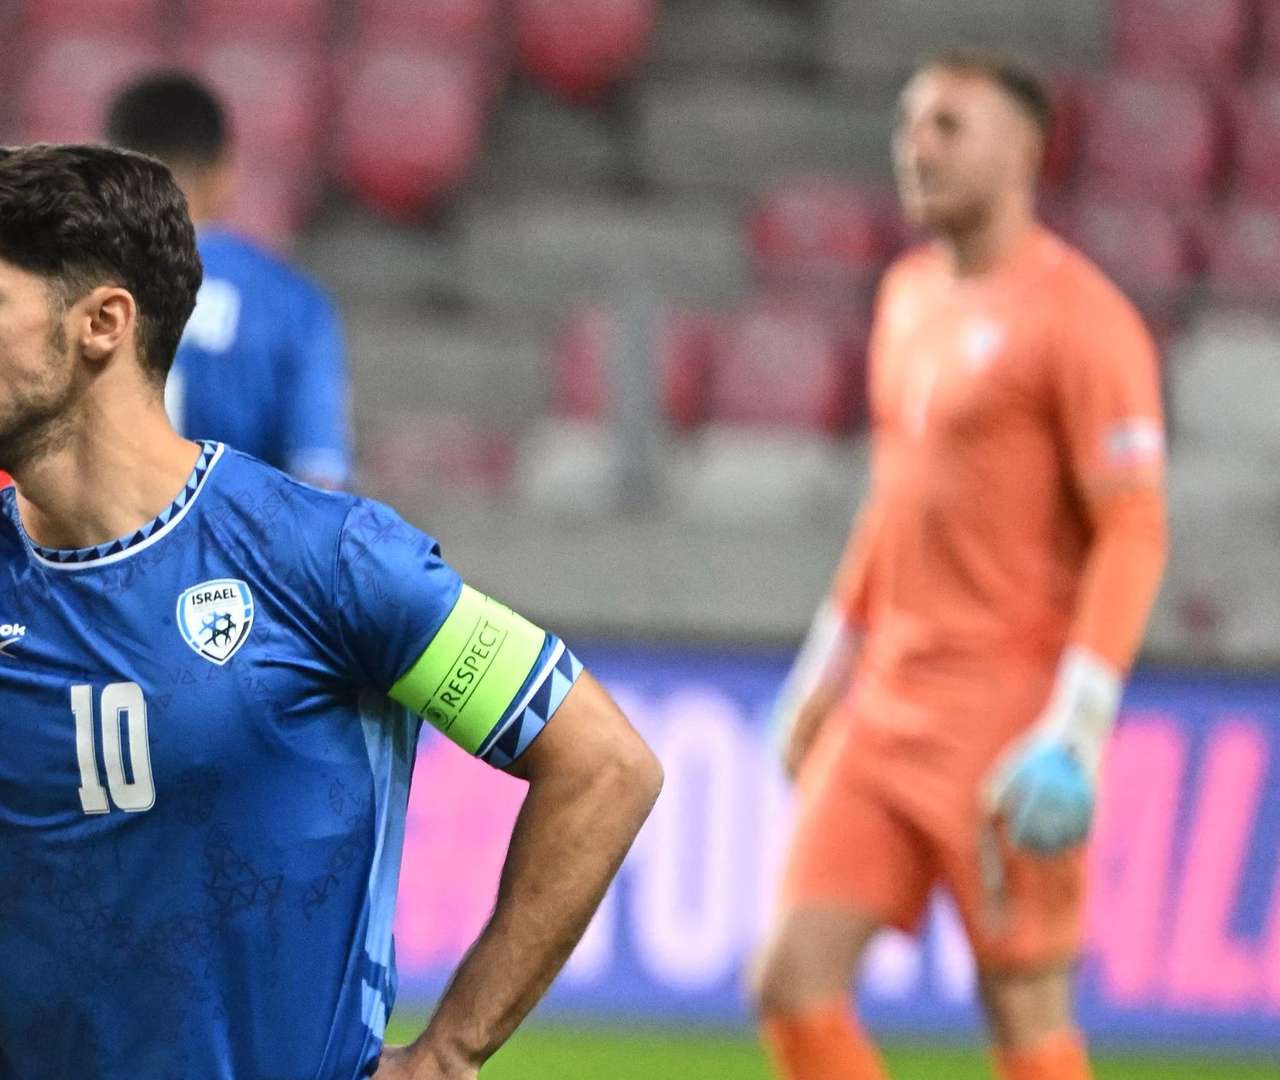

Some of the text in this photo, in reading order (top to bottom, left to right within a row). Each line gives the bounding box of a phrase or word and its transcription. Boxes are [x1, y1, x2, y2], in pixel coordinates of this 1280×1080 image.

[192, 588, 237, 605] ISRAEL
[440, 620, 501, 708] RESPECT
[70, 681, 156, 815] 10
